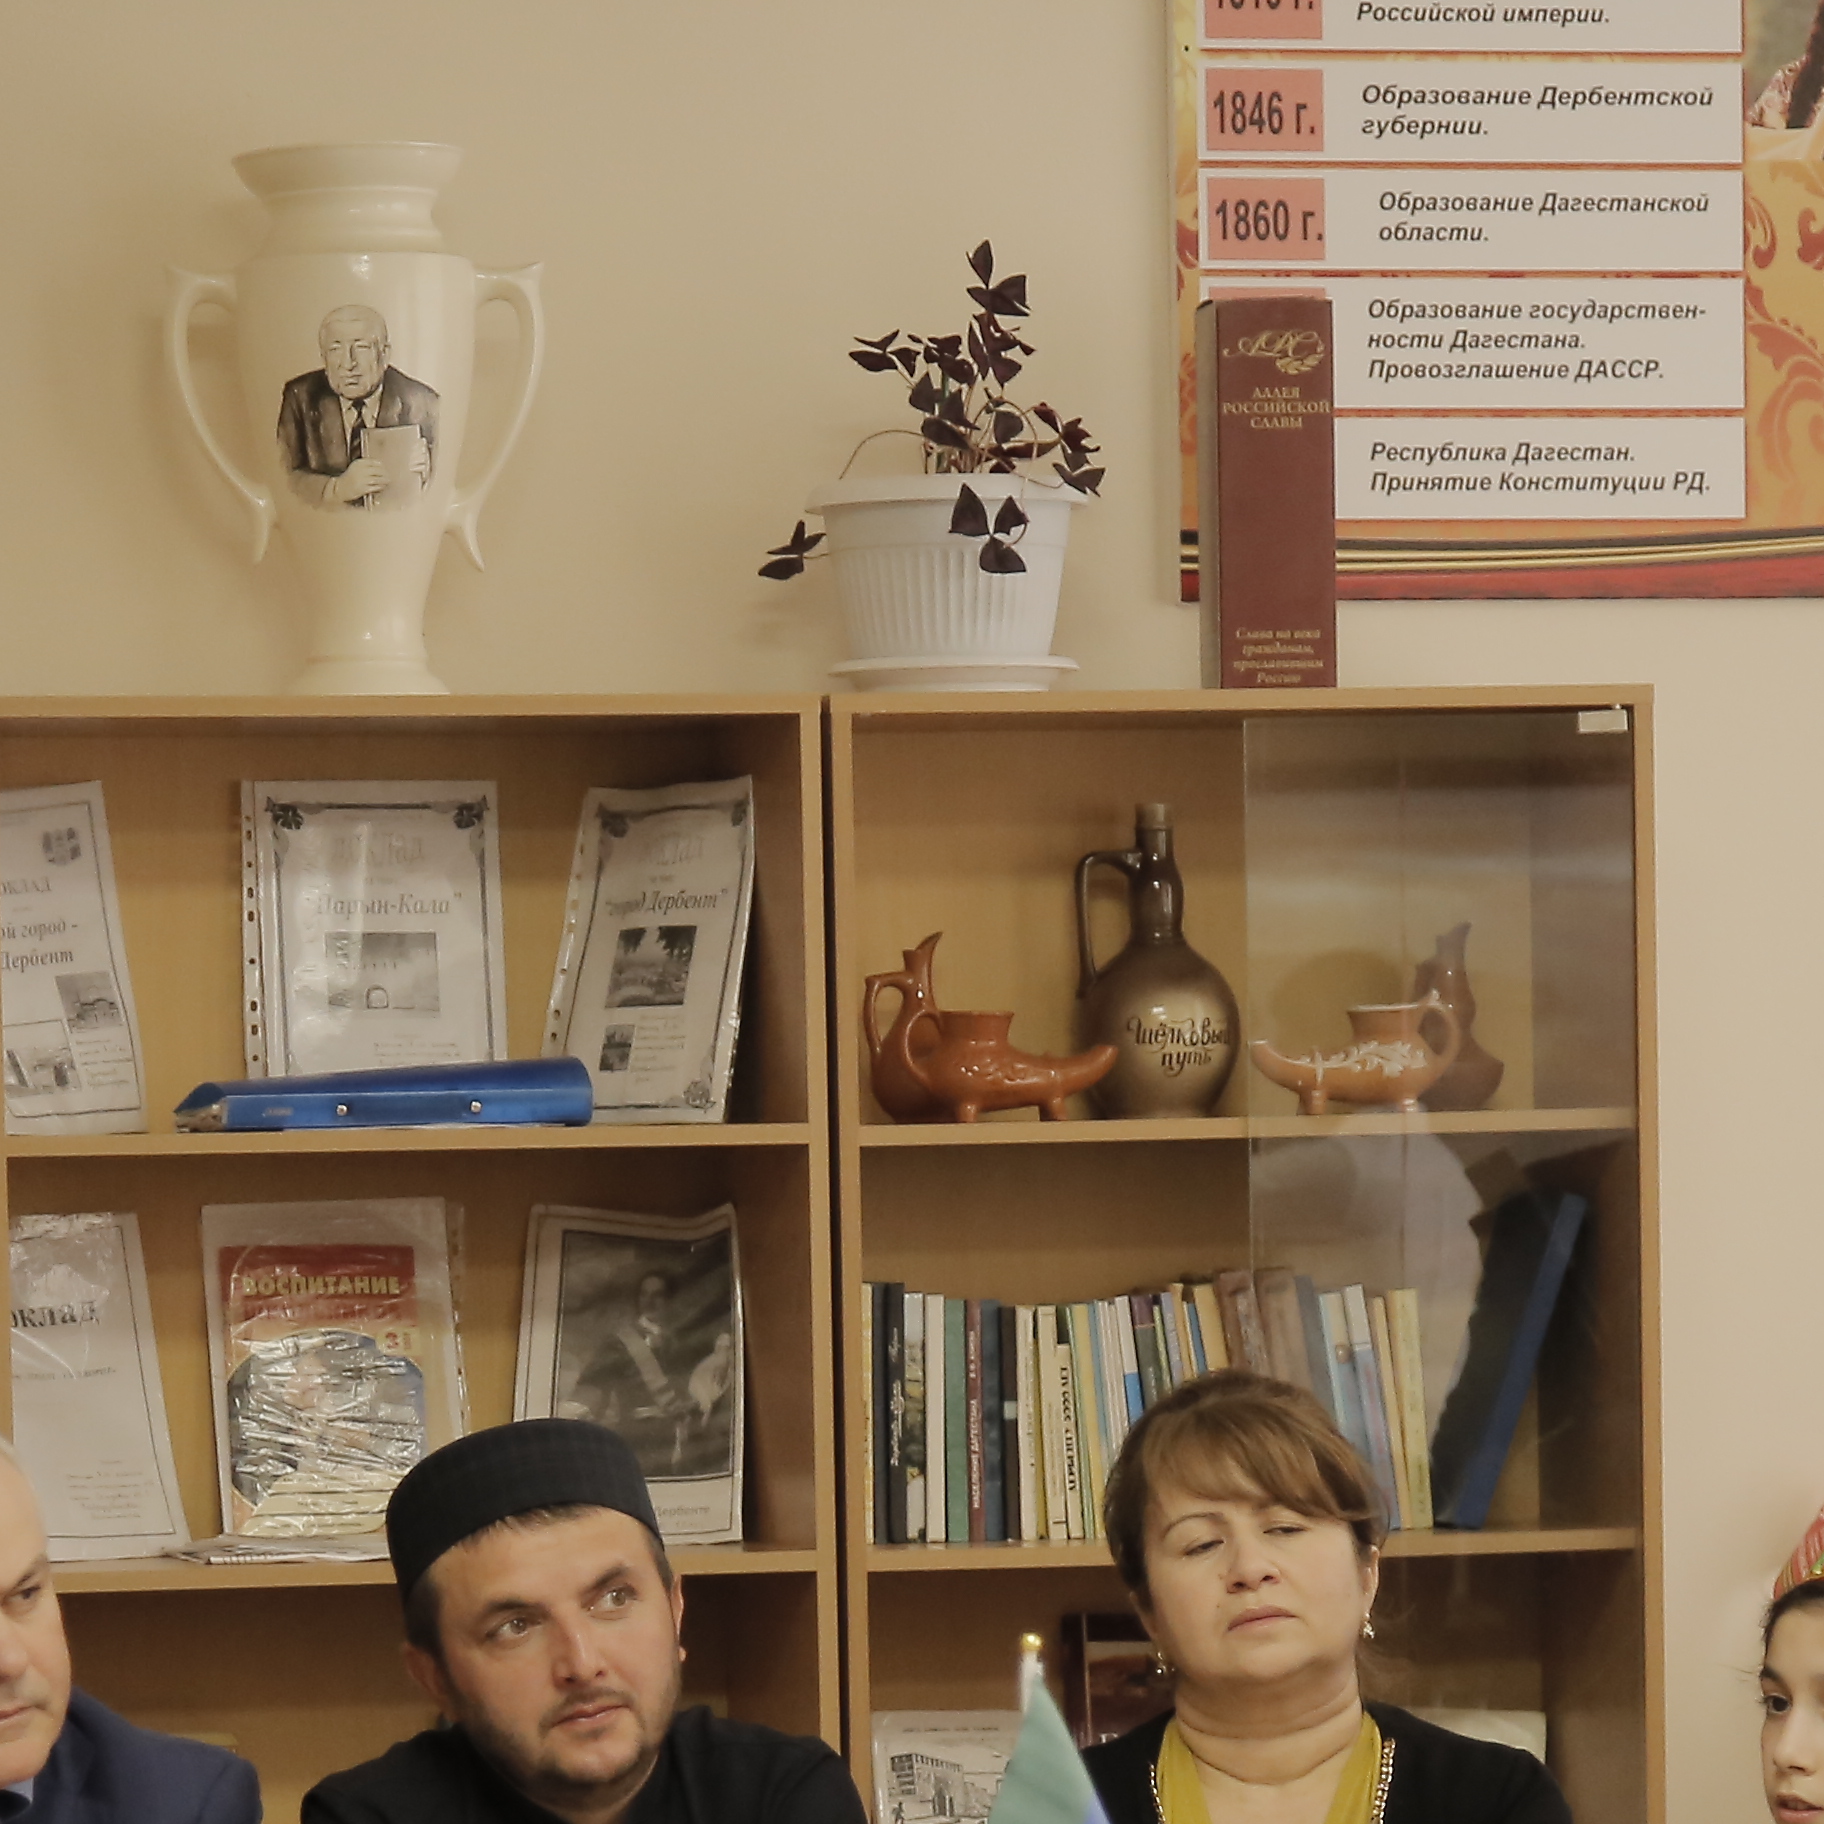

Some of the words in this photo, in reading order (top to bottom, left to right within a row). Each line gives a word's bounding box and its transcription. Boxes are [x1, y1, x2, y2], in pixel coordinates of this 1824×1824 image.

[1356, 1, 1496, 23] Российской
[1502, 8, 1609, 28] империи.
[1362, 84, 1532, 110] Образование
[1536, 85, 1713, 111] Дербентской
[1213, 90, 1284, 135] 1846
[1295, 102, 1315, 135] г.
[1361, 114, 1488, 140] губернии.
[1379, 191, 1534, 217] Образование
[1538, 192, 1709, 216] Дагестанской
[1215, 199, 1290, 242] 1860
[1302, 210, 1323, 242] г.
[1379, 221, 1488, 242] области.
[1368, 298, 1523, 324] Образование
[1529, 298, 1706, 324] государствен-
[1367, 333, 1444, 349] ности
[1448, 329, 1585, 354] Дагестана.
[1368, 359, 1570, 384] Провозглашение
[1573, 359, 1663, 384] ДАССР.
[1252, 387, 1300, 398] АЛЛЕЯ
[1223, 400, 1331, 414] РОССИЙСКОЙ
[1250, 416, 1303, 429] СЛАВЫ
[1370, 441, 1507, 467] Республика
[1511, 442, 1634, 466] Дагестан.
[1370, 472, 1492, 496] Принятие
[1498, 472, 1666, 496] Конституции
[1672, 471, 1710, 495] РД.
[242, 1274, 401, 1297] ВОСПИТАНИЕ
